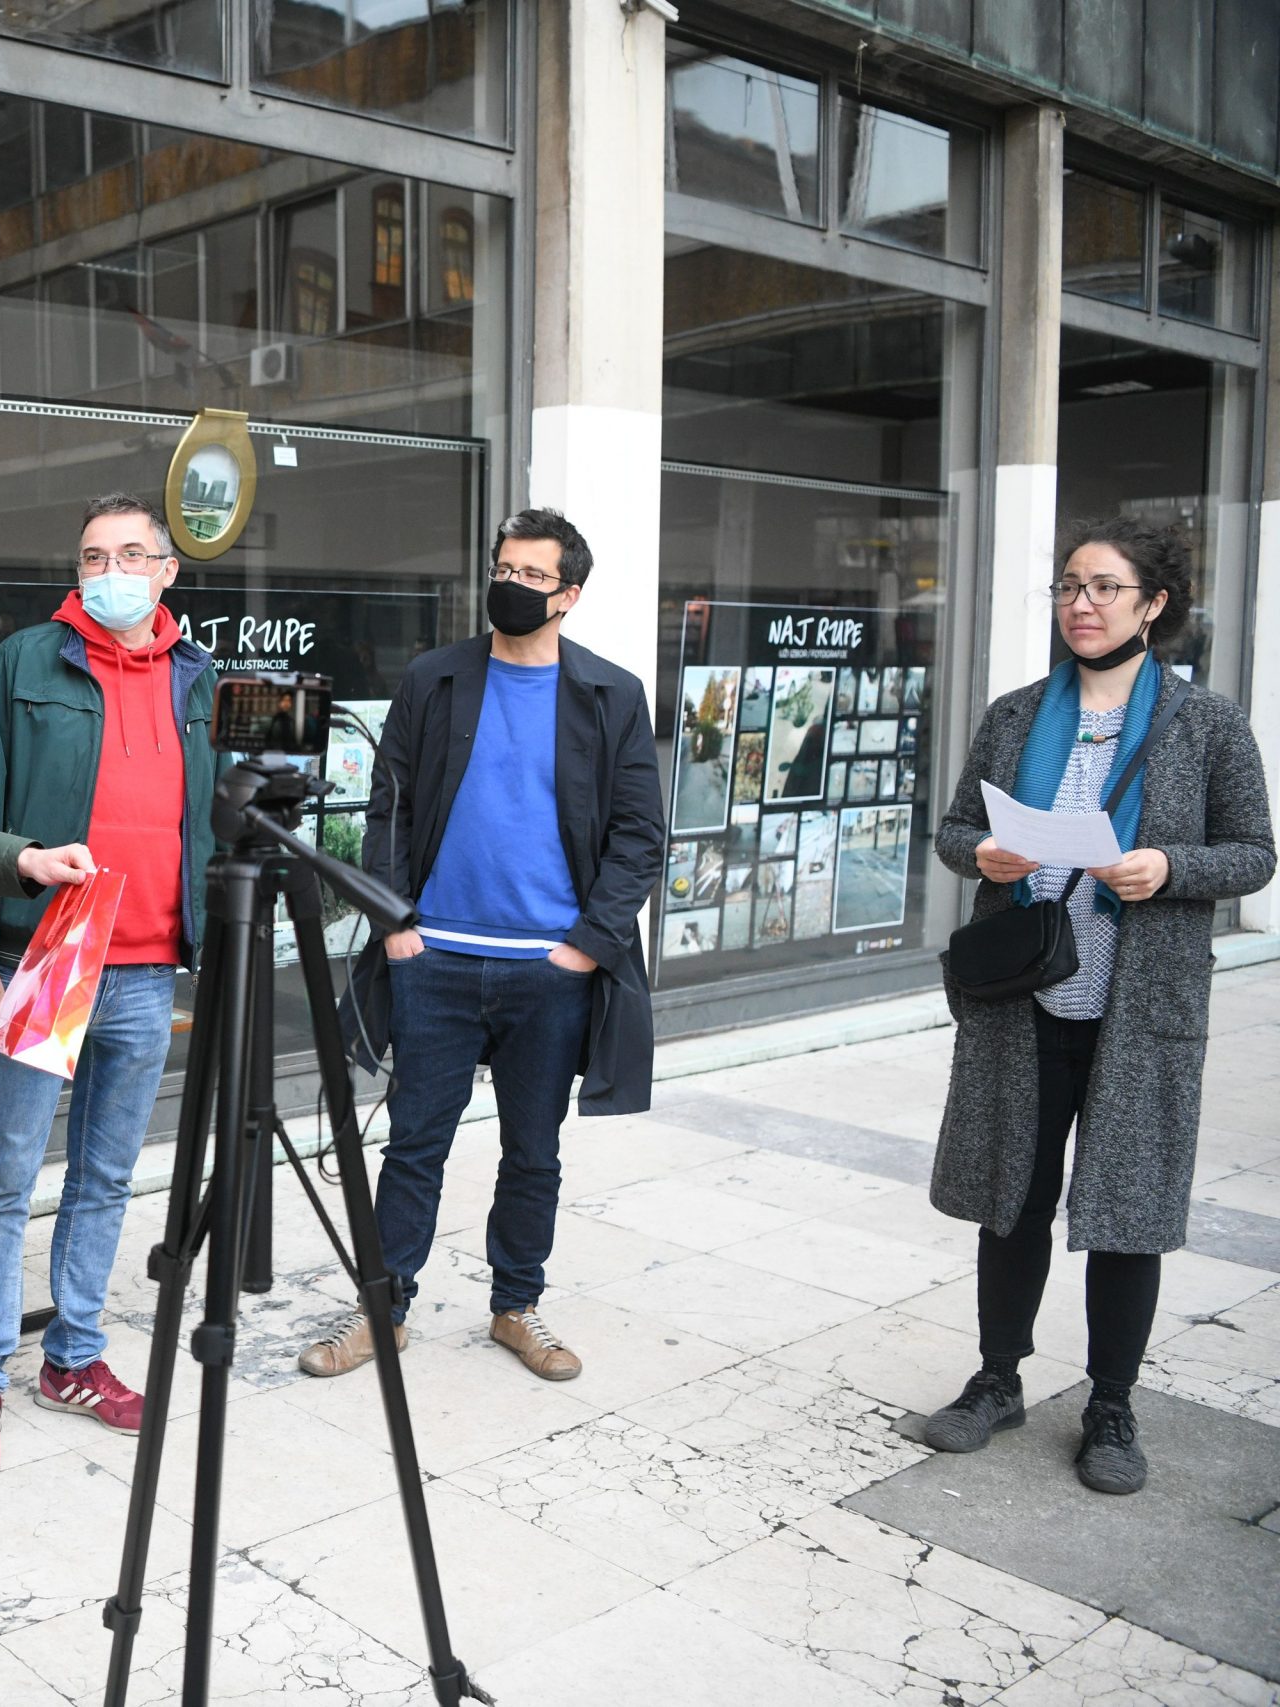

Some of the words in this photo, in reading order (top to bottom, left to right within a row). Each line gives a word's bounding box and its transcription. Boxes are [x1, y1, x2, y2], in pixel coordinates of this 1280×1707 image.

[179, 614, 230, 654] AJ
[237, 615, 316, 655] RUPE
[768, 615, 815, 646] NAJ
[816, 617, 864, 648] RUPE
[231, 659, 289, 671] ILUSTRACIJE
